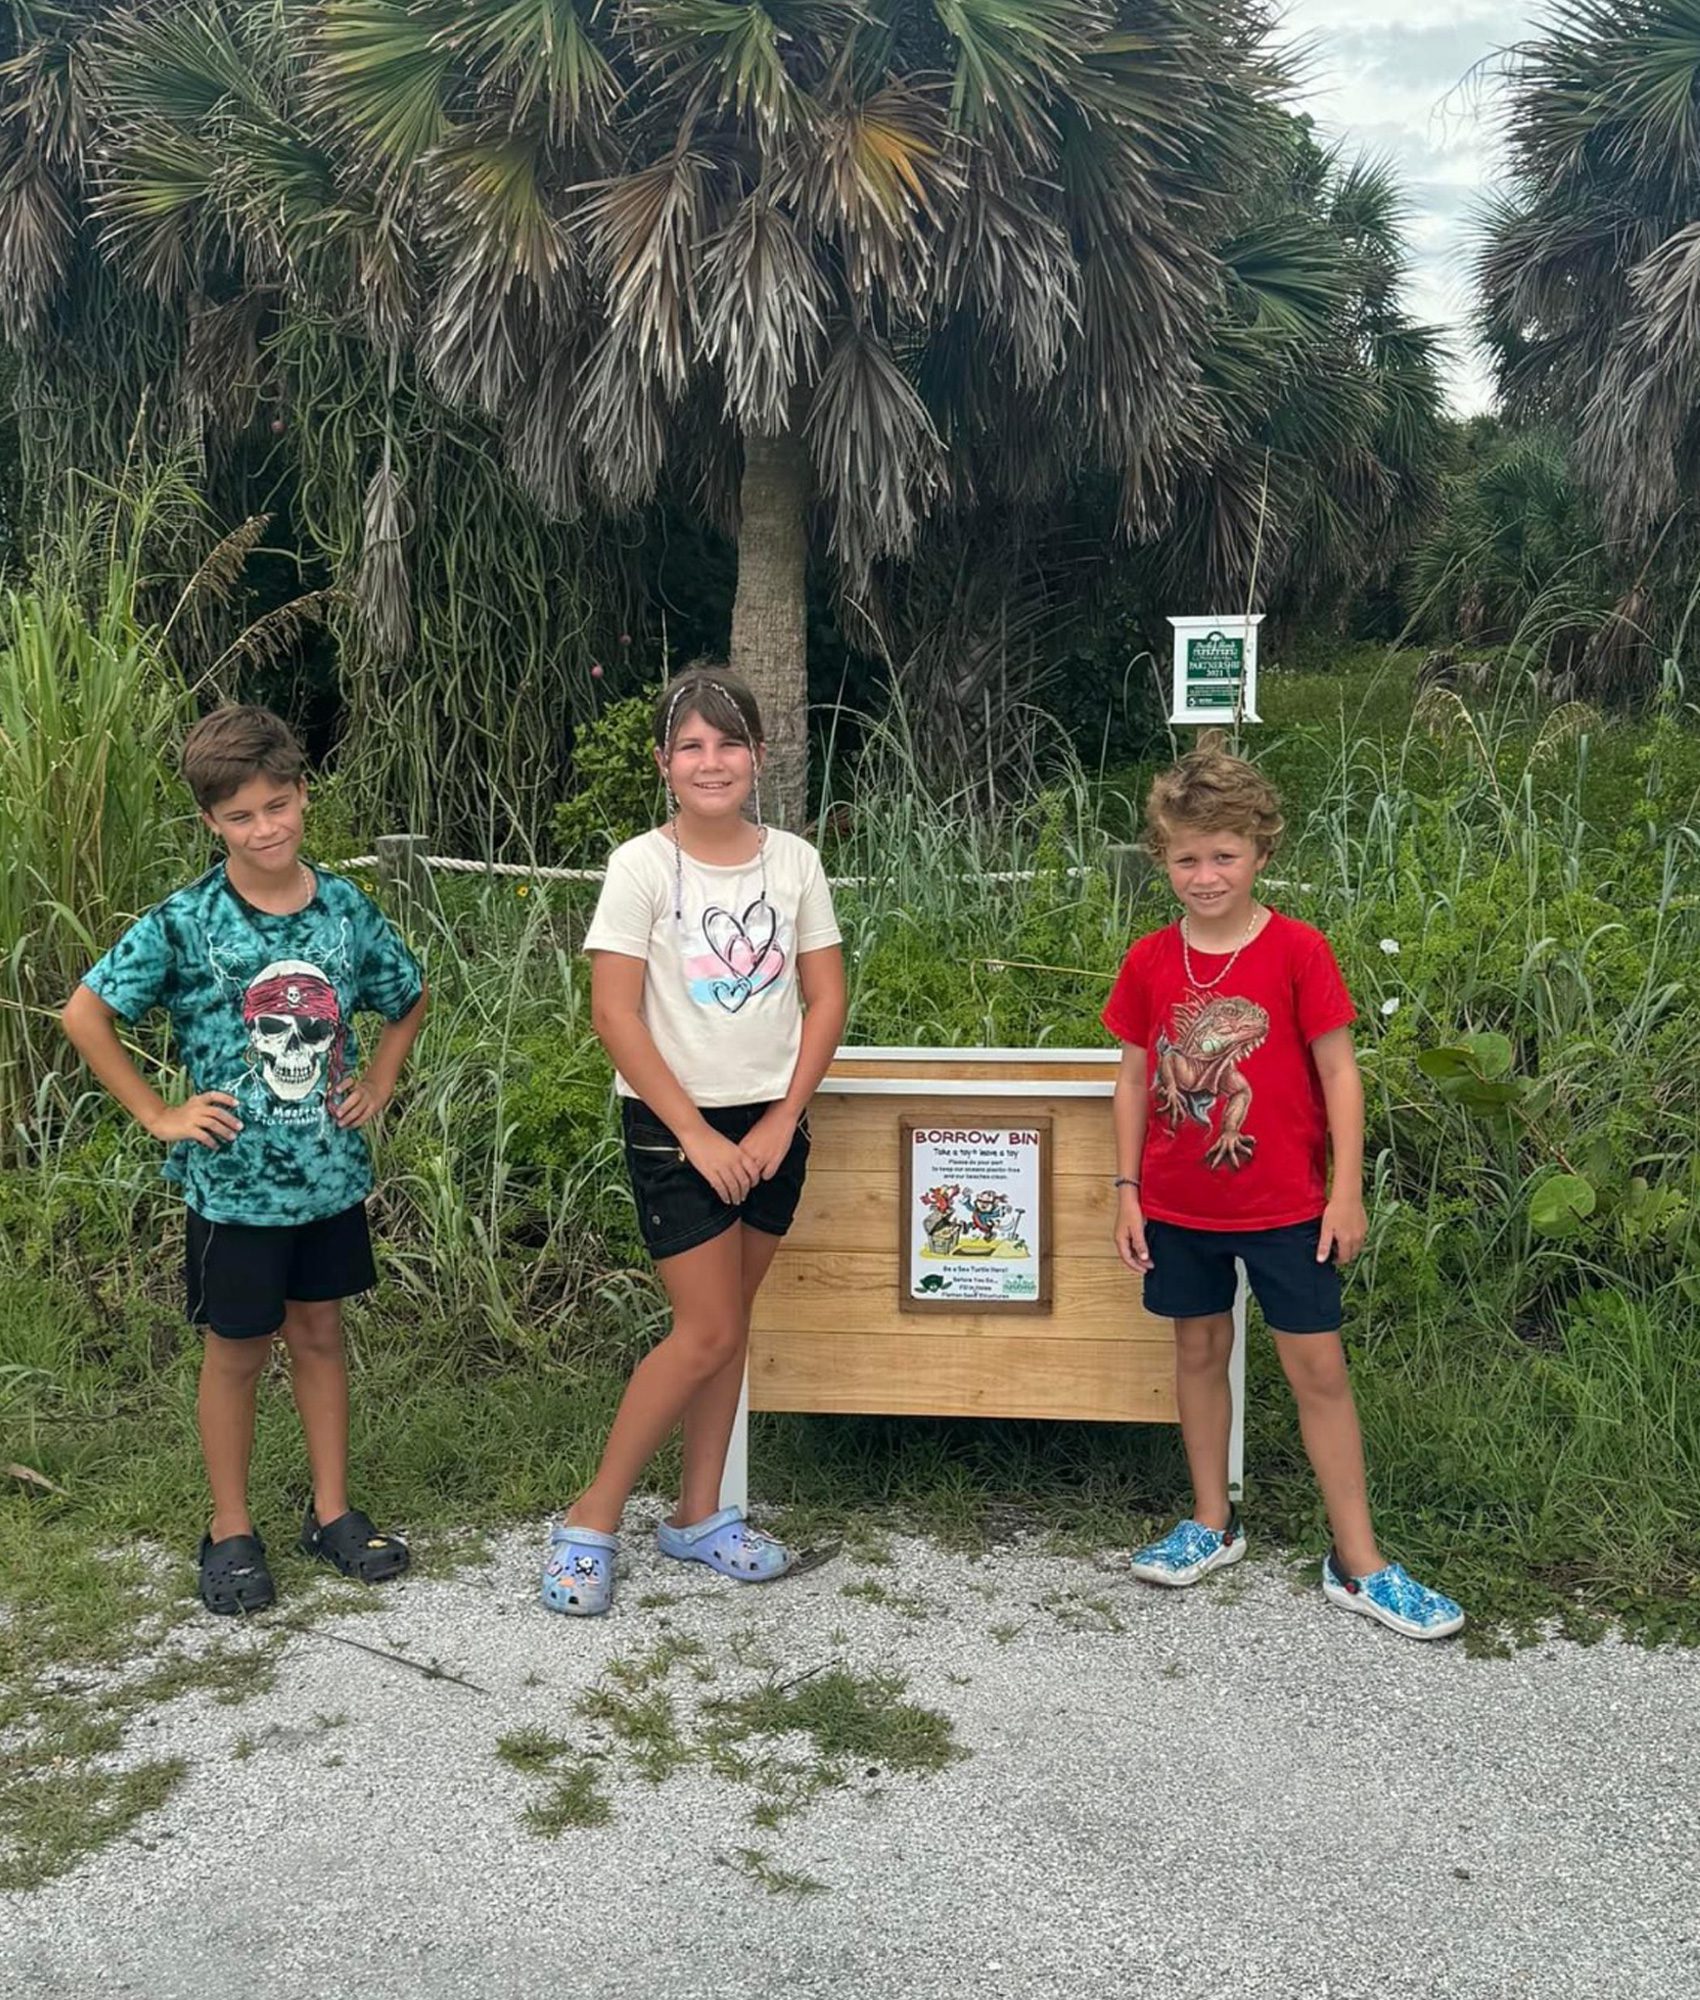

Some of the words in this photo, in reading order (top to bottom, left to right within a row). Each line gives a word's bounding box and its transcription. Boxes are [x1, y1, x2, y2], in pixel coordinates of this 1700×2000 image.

[915, 1130, 1000, 1144] BORROW
[1009, 1132, 1038, 1145] BIN
[933, 1148, 950, 1156] Take
[1006, 1150, 1018, 1159] toy
